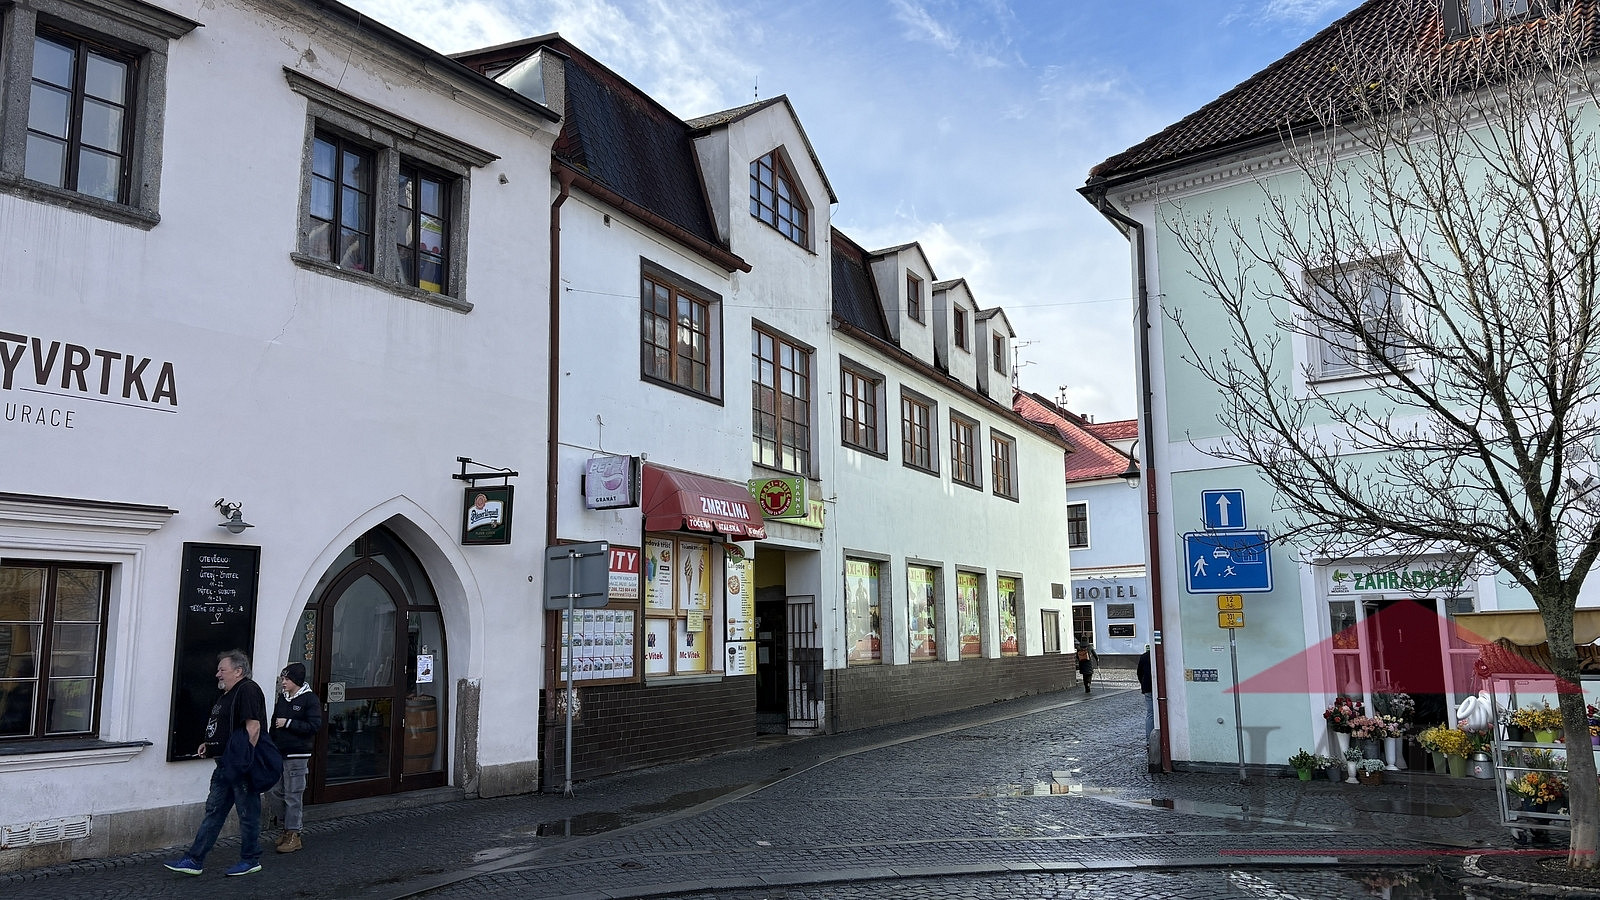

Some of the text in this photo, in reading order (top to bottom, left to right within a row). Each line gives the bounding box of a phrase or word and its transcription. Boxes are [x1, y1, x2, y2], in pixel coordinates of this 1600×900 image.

[5, 402, 76, 429] URACE
[700, 496, 749, 519] ZMRZLINA
[1075, 585, 1138, 600] HOTEL
